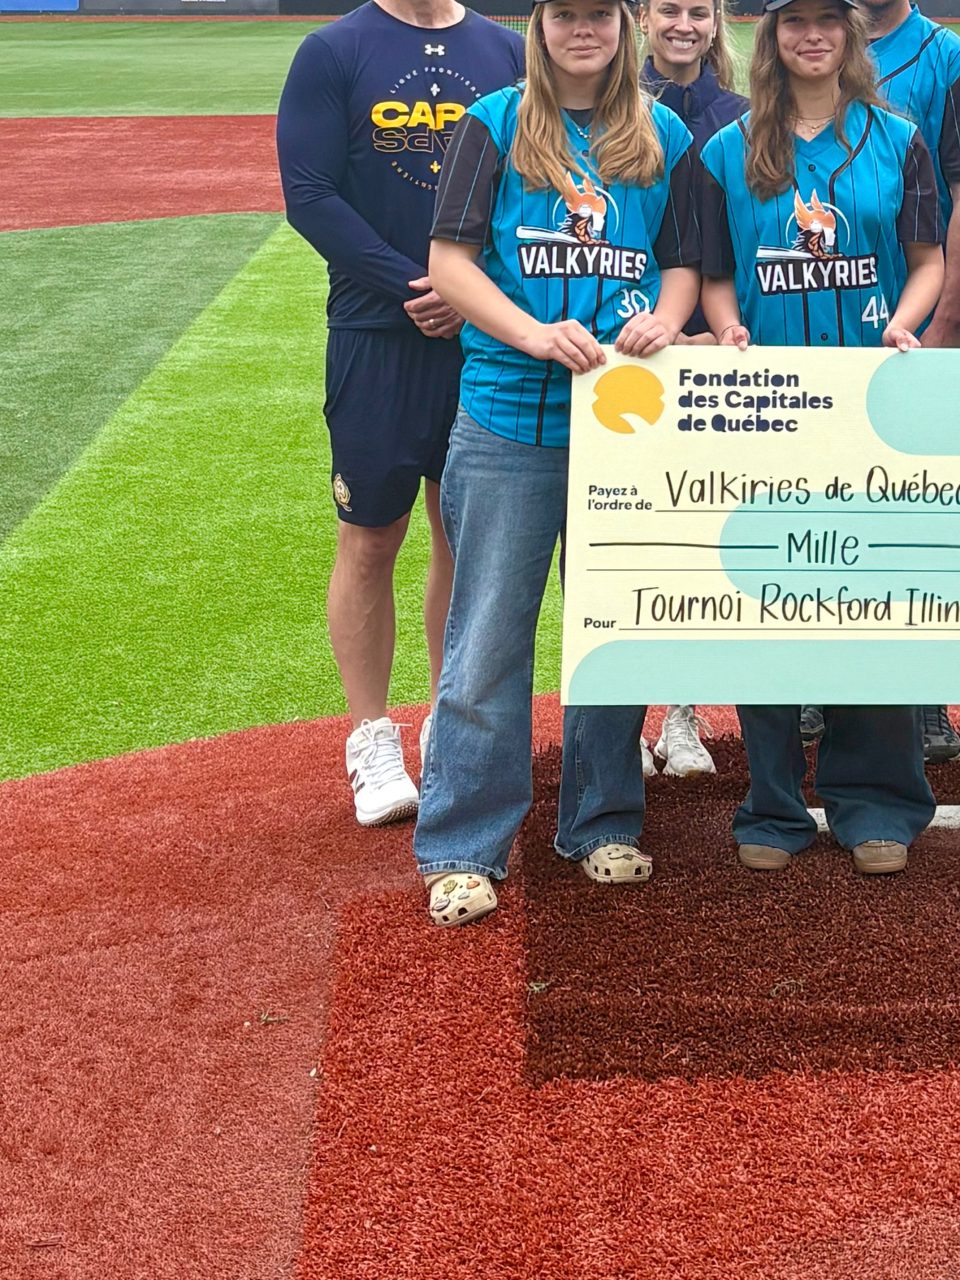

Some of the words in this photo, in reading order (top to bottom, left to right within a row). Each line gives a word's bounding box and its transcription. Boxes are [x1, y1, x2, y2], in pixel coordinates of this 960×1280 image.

[371, 101, 467, 130] CAP
[520, 245, 648, 281] VALKYRIES
[756, 256, 879, 293] VALKYRIES
[616, 288, 651, 319] 30
[861, 293, 891, 329] 44
[679, 368, 800, 388] Fondation
[677, 390, 719, 409] des
[724, 391, 834, 413] Capitales
[677, 414, 707, 432] de
[710, 413, 799, 433] Québec
[587, 484, 629, 499] Payez
[630, 484, 639, 497] à
[665, 470, 812, 507] Valkiries
[825, 476, 855, 503] de
[587, 499, 634, 512] l'ordre
[635, 499, 653, 511] de
[786, 529, 860, 566] Mille
[632, 586, 743, 625] Tournoi
[760, 582, 893, 625] Rockford
[583, 617, 617, 630] Pour
